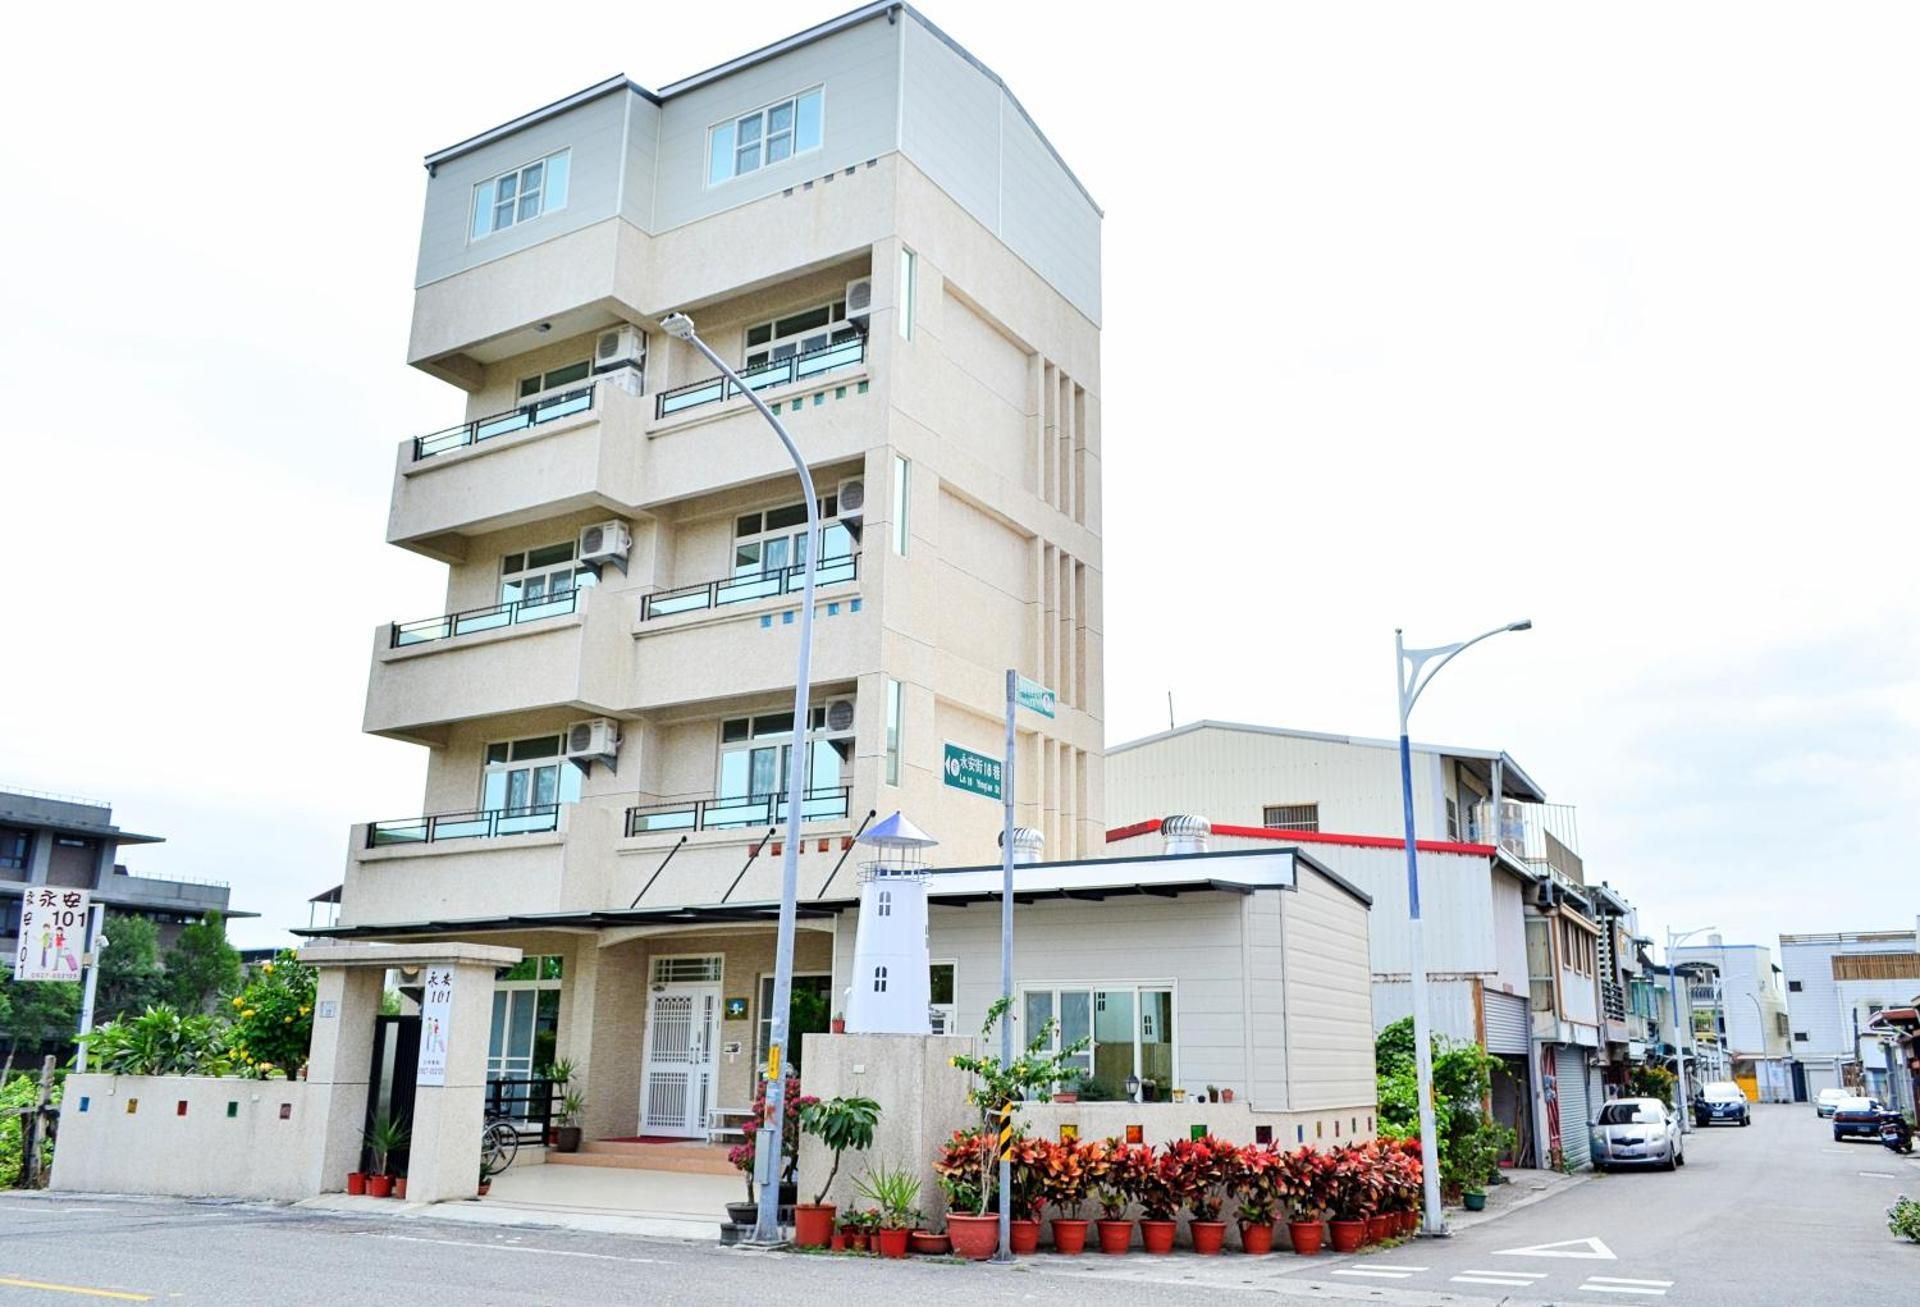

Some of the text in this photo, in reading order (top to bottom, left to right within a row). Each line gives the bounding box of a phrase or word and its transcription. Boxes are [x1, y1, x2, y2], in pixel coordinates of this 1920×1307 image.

[39, 890, 82, 908] 永安
[52, 911, 86, 928] 101
[428, 971, 452, 987] 永安
[431, 991, 451, 1004] 101
